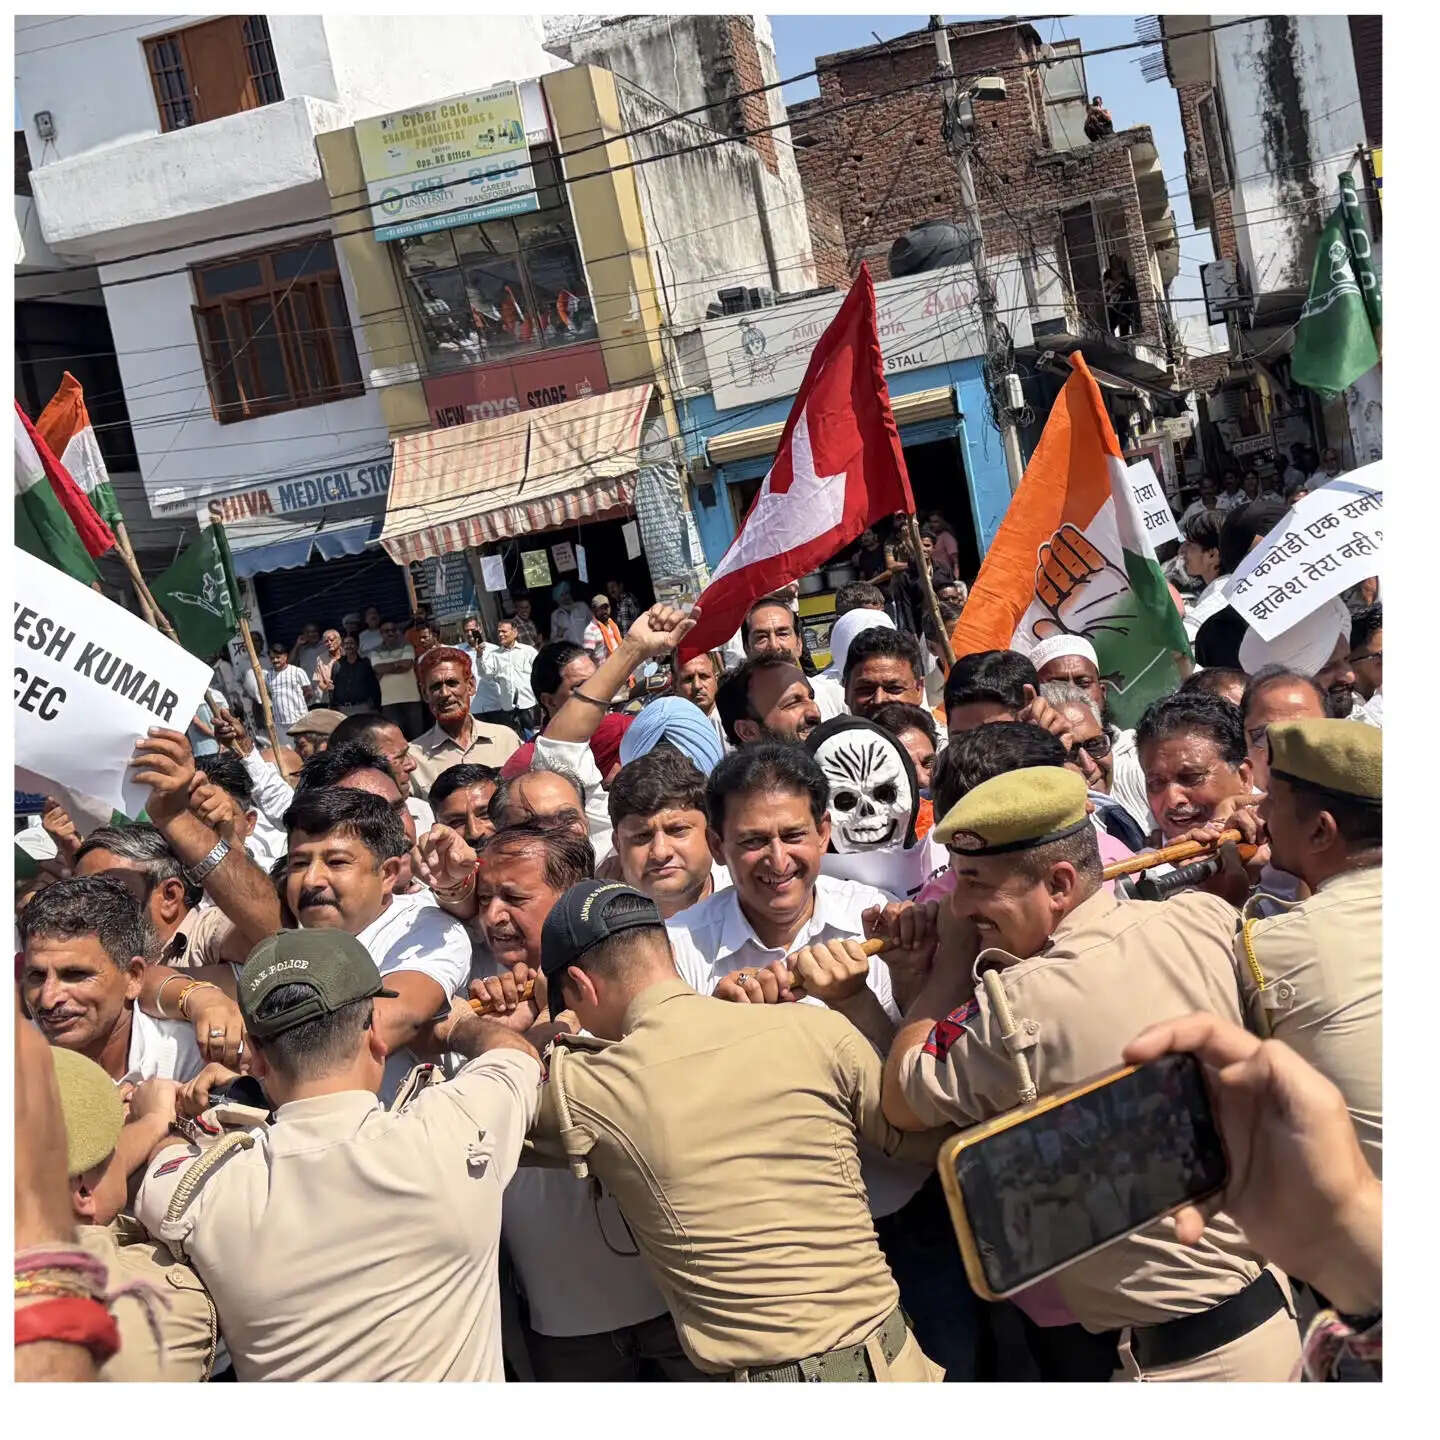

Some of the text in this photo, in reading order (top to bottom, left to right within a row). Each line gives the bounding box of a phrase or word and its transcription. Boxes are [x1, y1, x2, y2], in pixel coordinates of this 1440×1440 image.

[401, 101, 470, 128] Cyber Cafe
[416, 158, 434, 169] Opp.
[446, 149, 472, 163] Office
[404, 189, 455, 209] UNIVERSITY
[464, 183, 533, 204] TRANSFORMATION
[480, 180, 512, 194] CAREER
[887, 351, 929, 371] STALL
[436, 384, 568, 428] NEW TOYS STORE
[208, 463, 392, 522] SHIVA MEDICAL STO
[1303, 511, 1341, 540] एक
[1343, 489, 1382, 519] समो
[1300, 553, 1343, 583] तेरा
[14, 601, 179, 723] ESH KUMAR
[268, 959, 309, 975] POLICE
